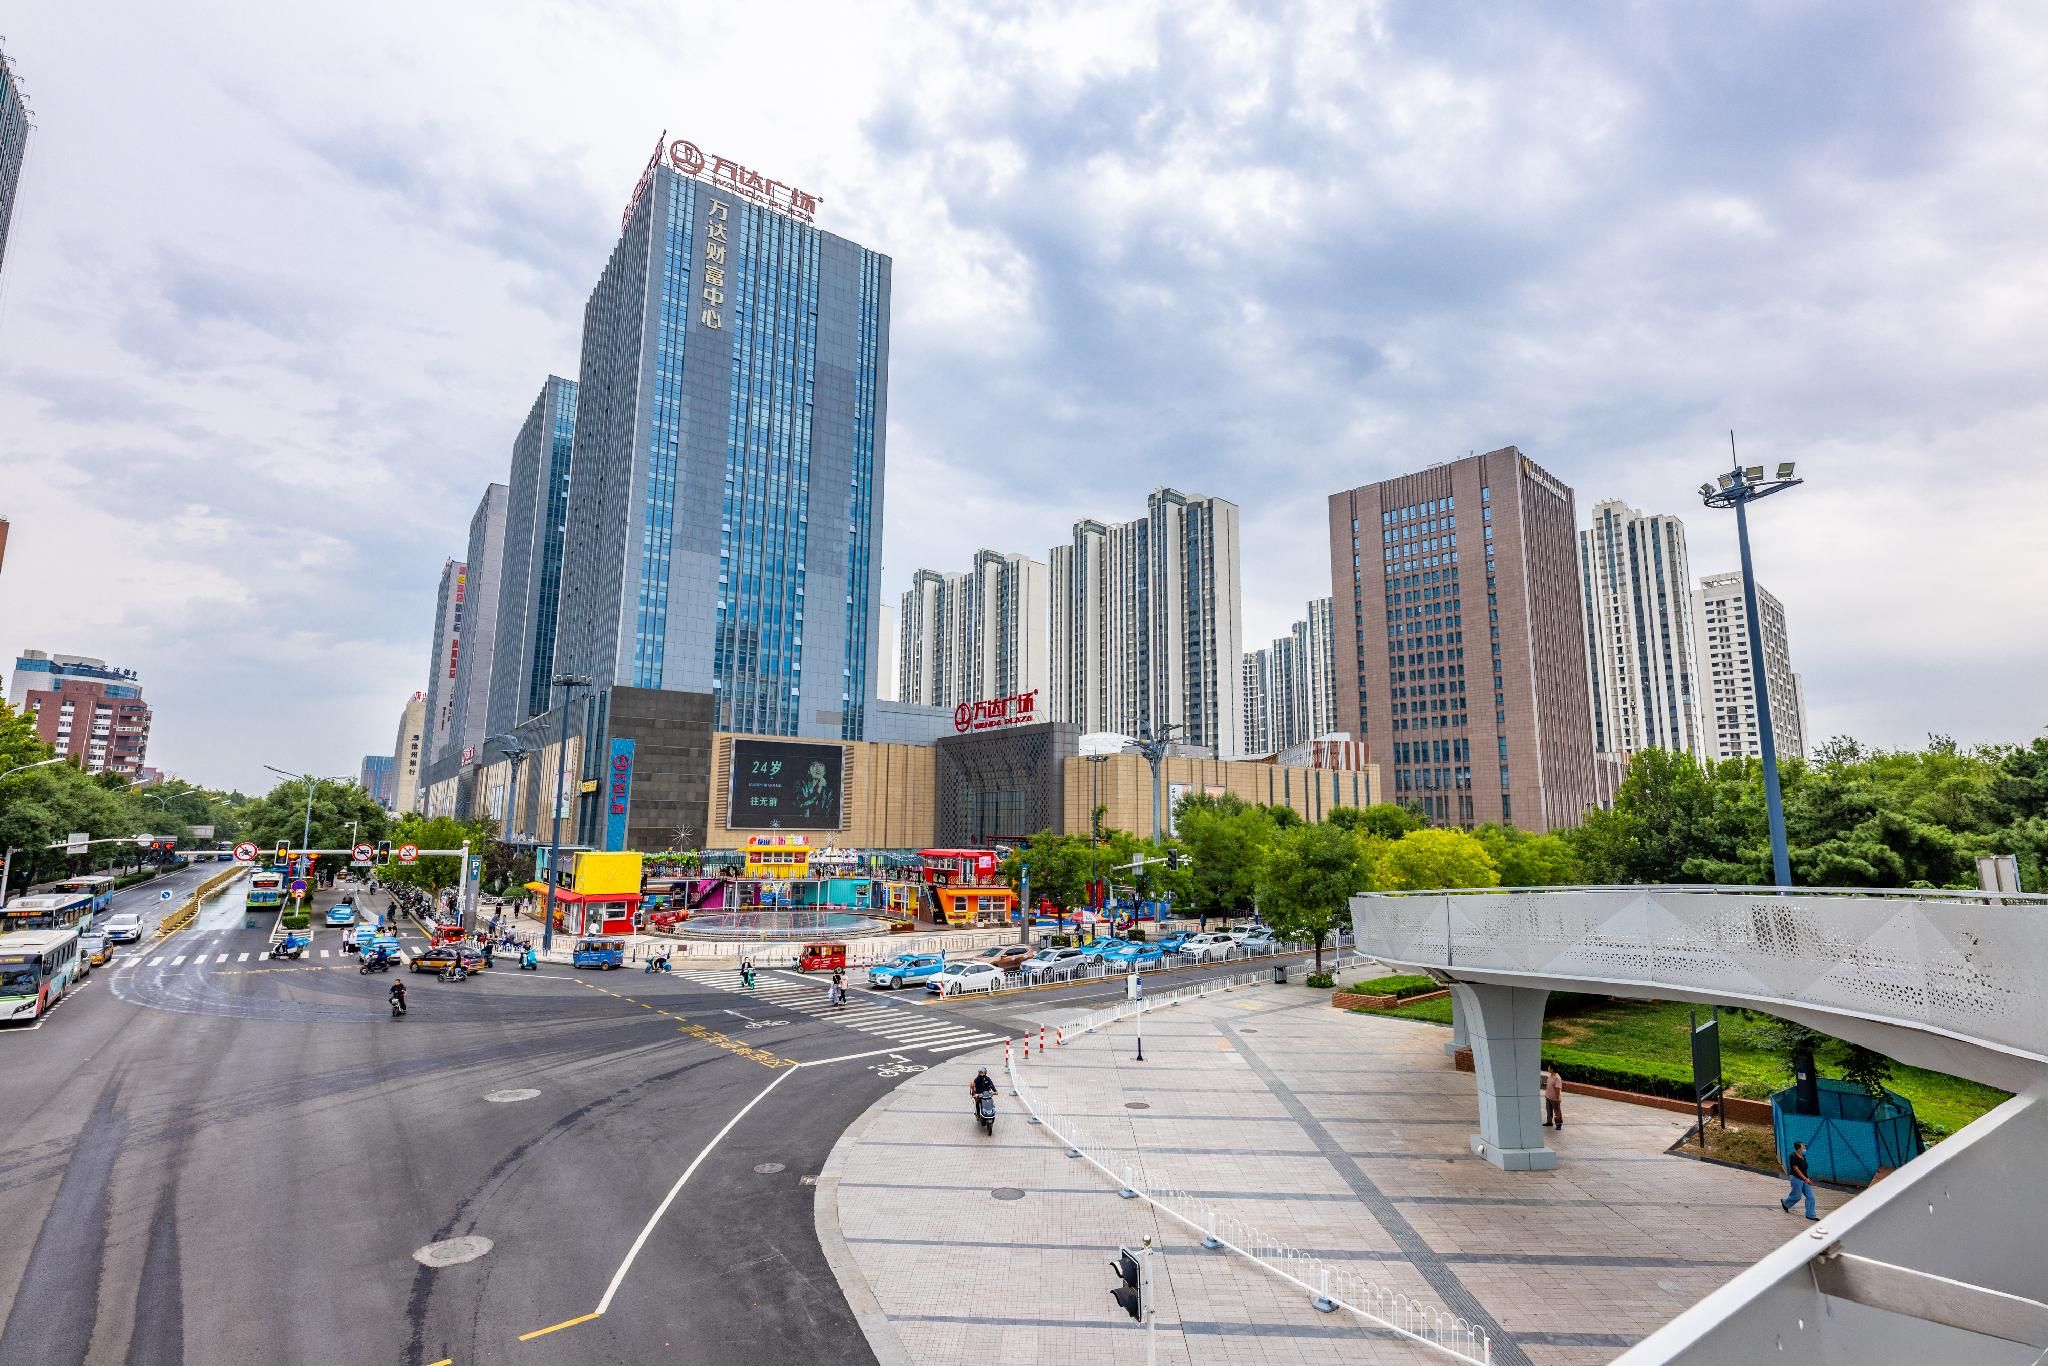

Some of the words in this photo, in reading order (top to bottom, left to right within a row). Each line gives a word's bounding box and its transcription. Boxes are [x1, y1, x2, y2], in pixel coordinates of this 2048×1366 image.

[712, 154, 817, 214] 万达广场
[712, 176, 765, 202] WANDA
[768, 199, 815, 223] PLAZA
[700, 198, 730, 330] 万达财富中心
[973, 692, 1034, 720] 万达广场
[974, 720, 1002, 729] WANDA
[1005, 715, 1033, 725] PLAZA
[751, 760, 782, 776] 24岁
